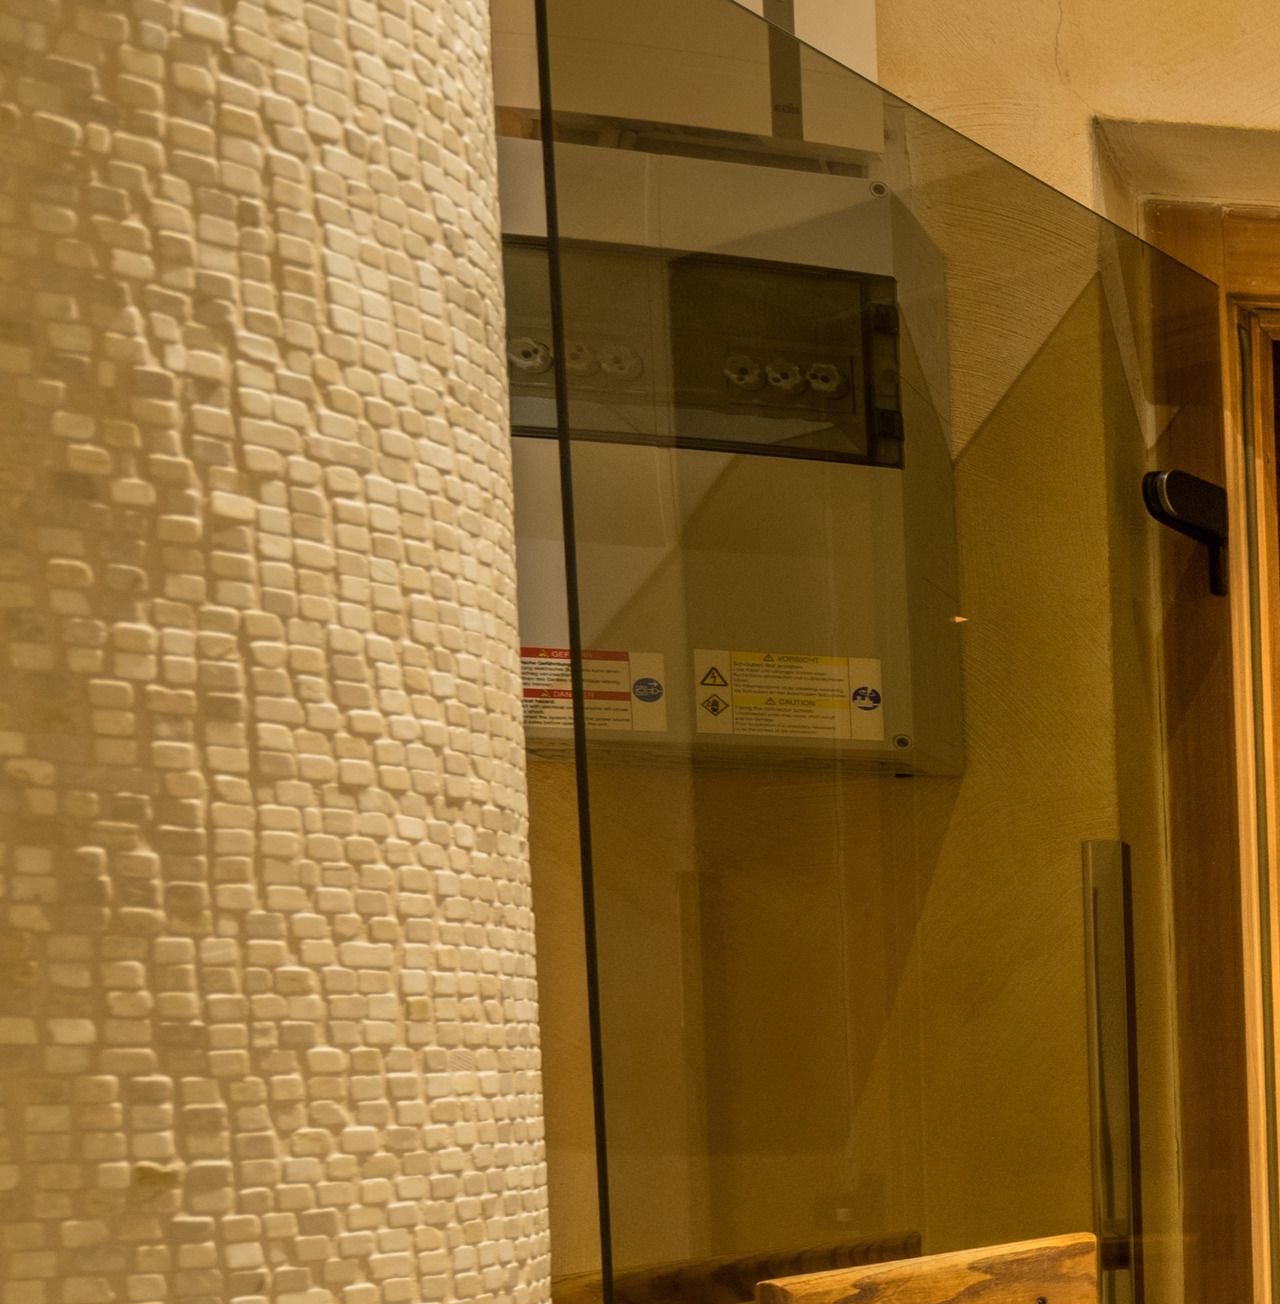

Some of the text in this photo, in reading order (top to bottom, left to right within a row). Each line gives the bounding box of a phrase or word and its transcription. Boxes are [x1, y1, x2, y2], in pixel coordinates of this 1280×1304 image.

[551, 650, 593, 659] GEFHR
[552, 690, 595, 698] DANER
[778, 698, 816, 706] CAUTION
